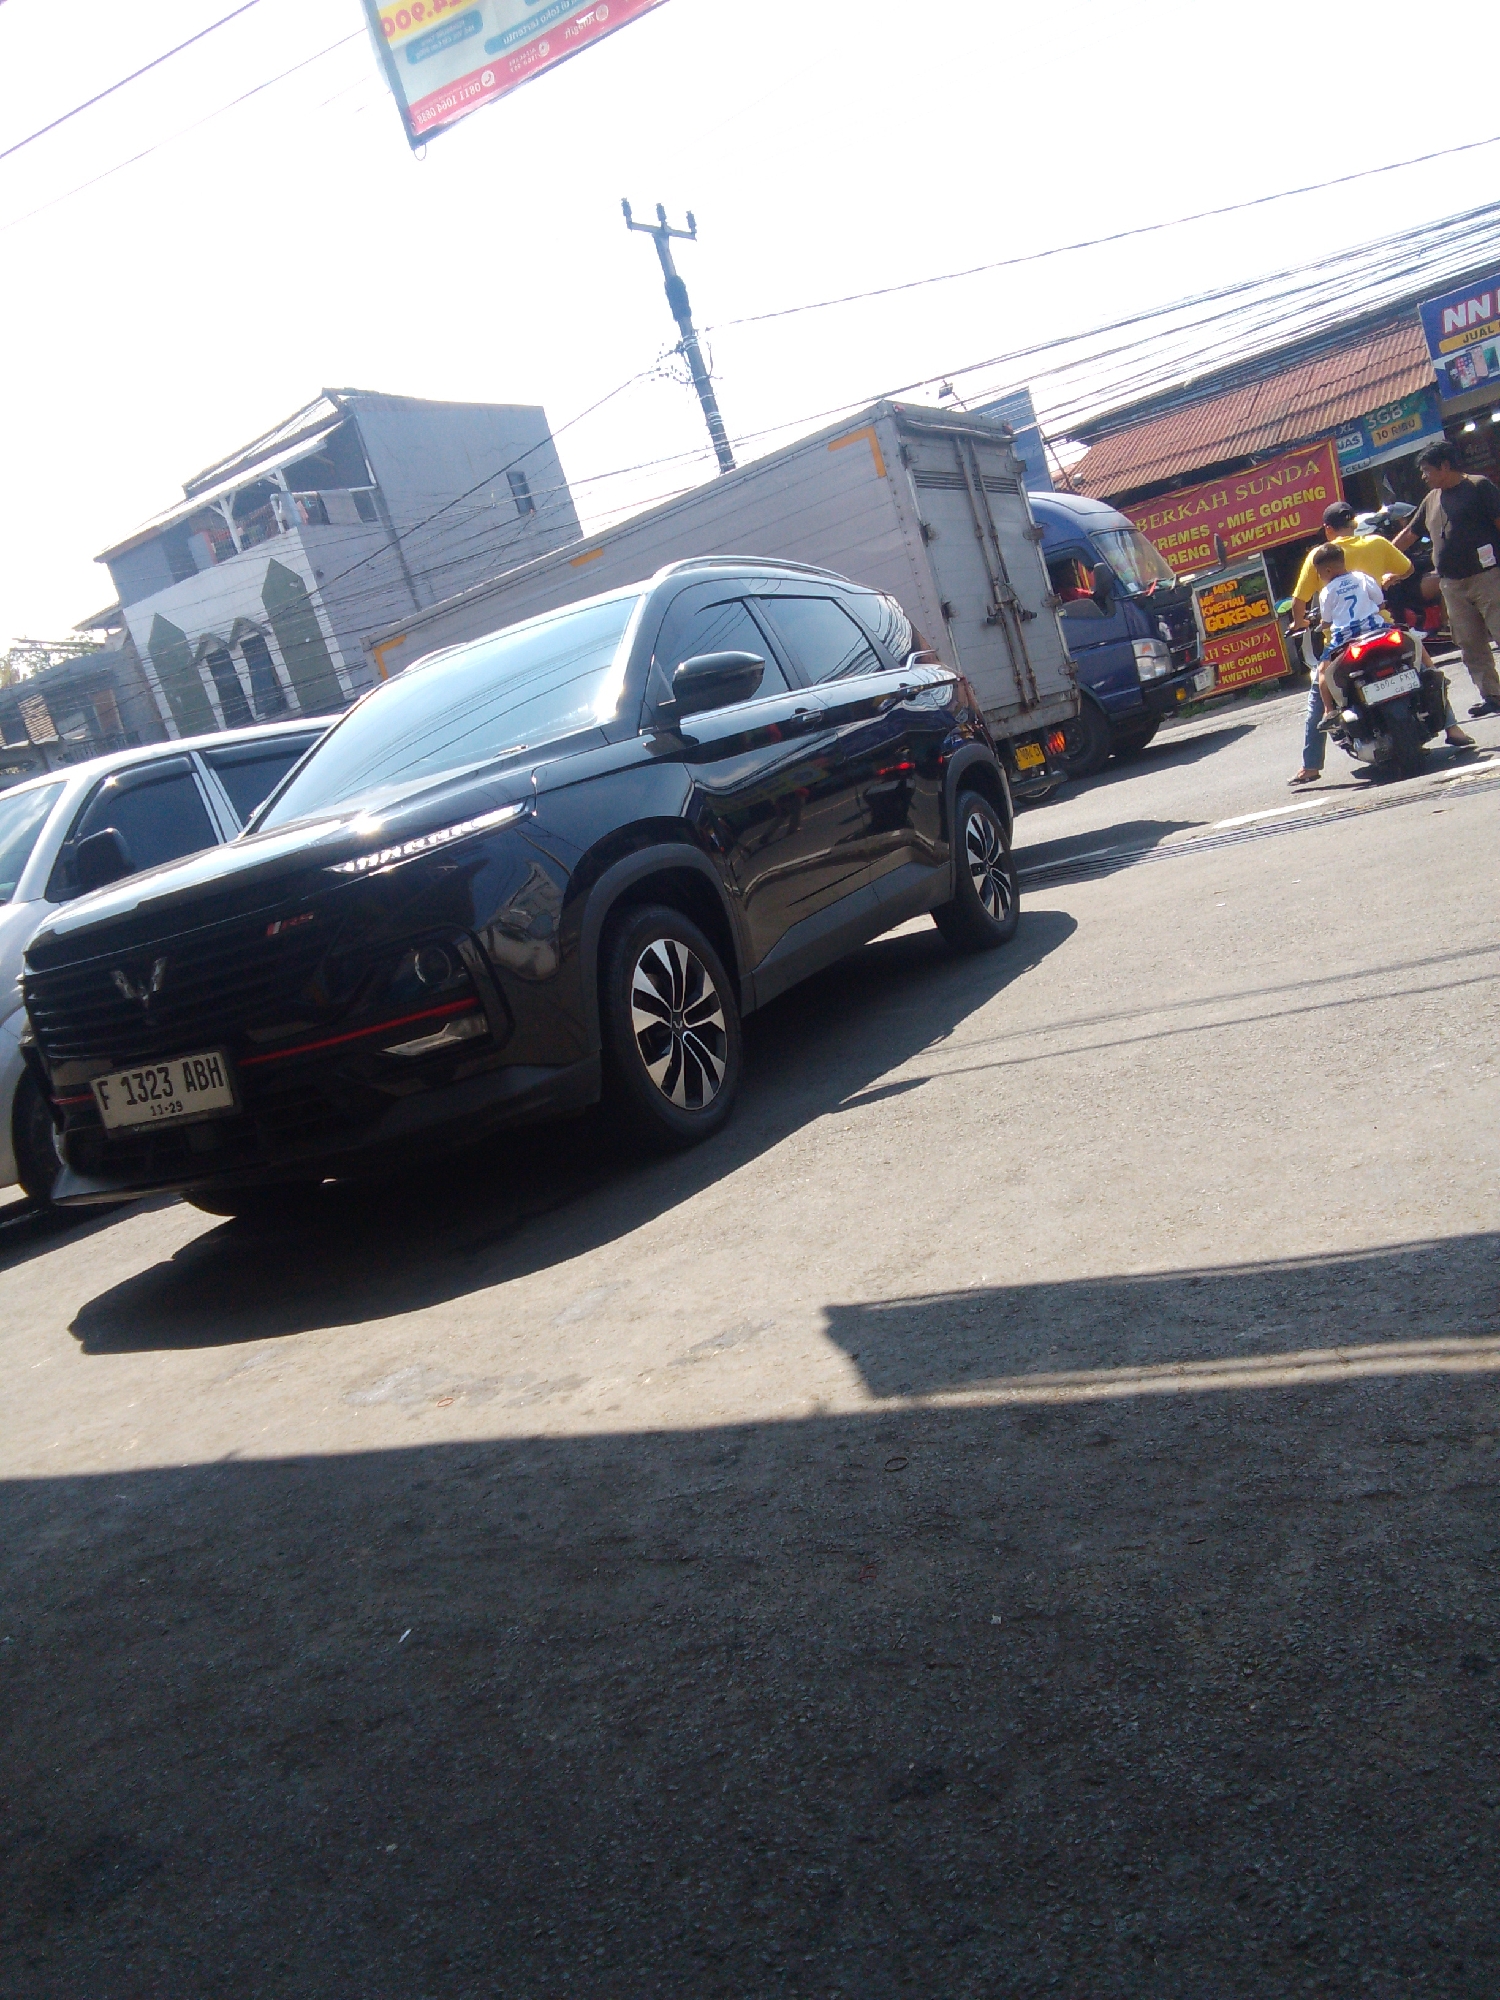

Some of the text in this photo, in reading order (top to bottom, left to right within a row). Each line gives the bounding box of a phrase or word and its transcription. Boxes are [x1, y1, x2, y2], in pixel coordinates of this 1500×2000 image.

[1443, 293, 1491, 334] NN
[1463, 325, 1494, 343] JUAL
[1340, 422, 1354, 435] XL
[1366, 404, 1403, 429] 3GB
[1376, 419, 1416, 440] 10 RIBU
[1136, 459, 1320, 533] BERKAH SUNDA
[1152, 486, 1326, 551] REMES MIE GORENG
[1231, 512, 1301, 548] KWETIAU
[1202, 595, 1246, 617] KWETIAU
[1205, 599, 1271, 633] GORENG
[1344, 594, 1358, 619] 7
[1221, 632, 1271, 656] SUNDA
[1219, 648, 1277, 673] MIE GORENG
[1222, 665, 1263, 685] KWETIAU
[97, 1056, 224, 1110] F 1323 ABH
